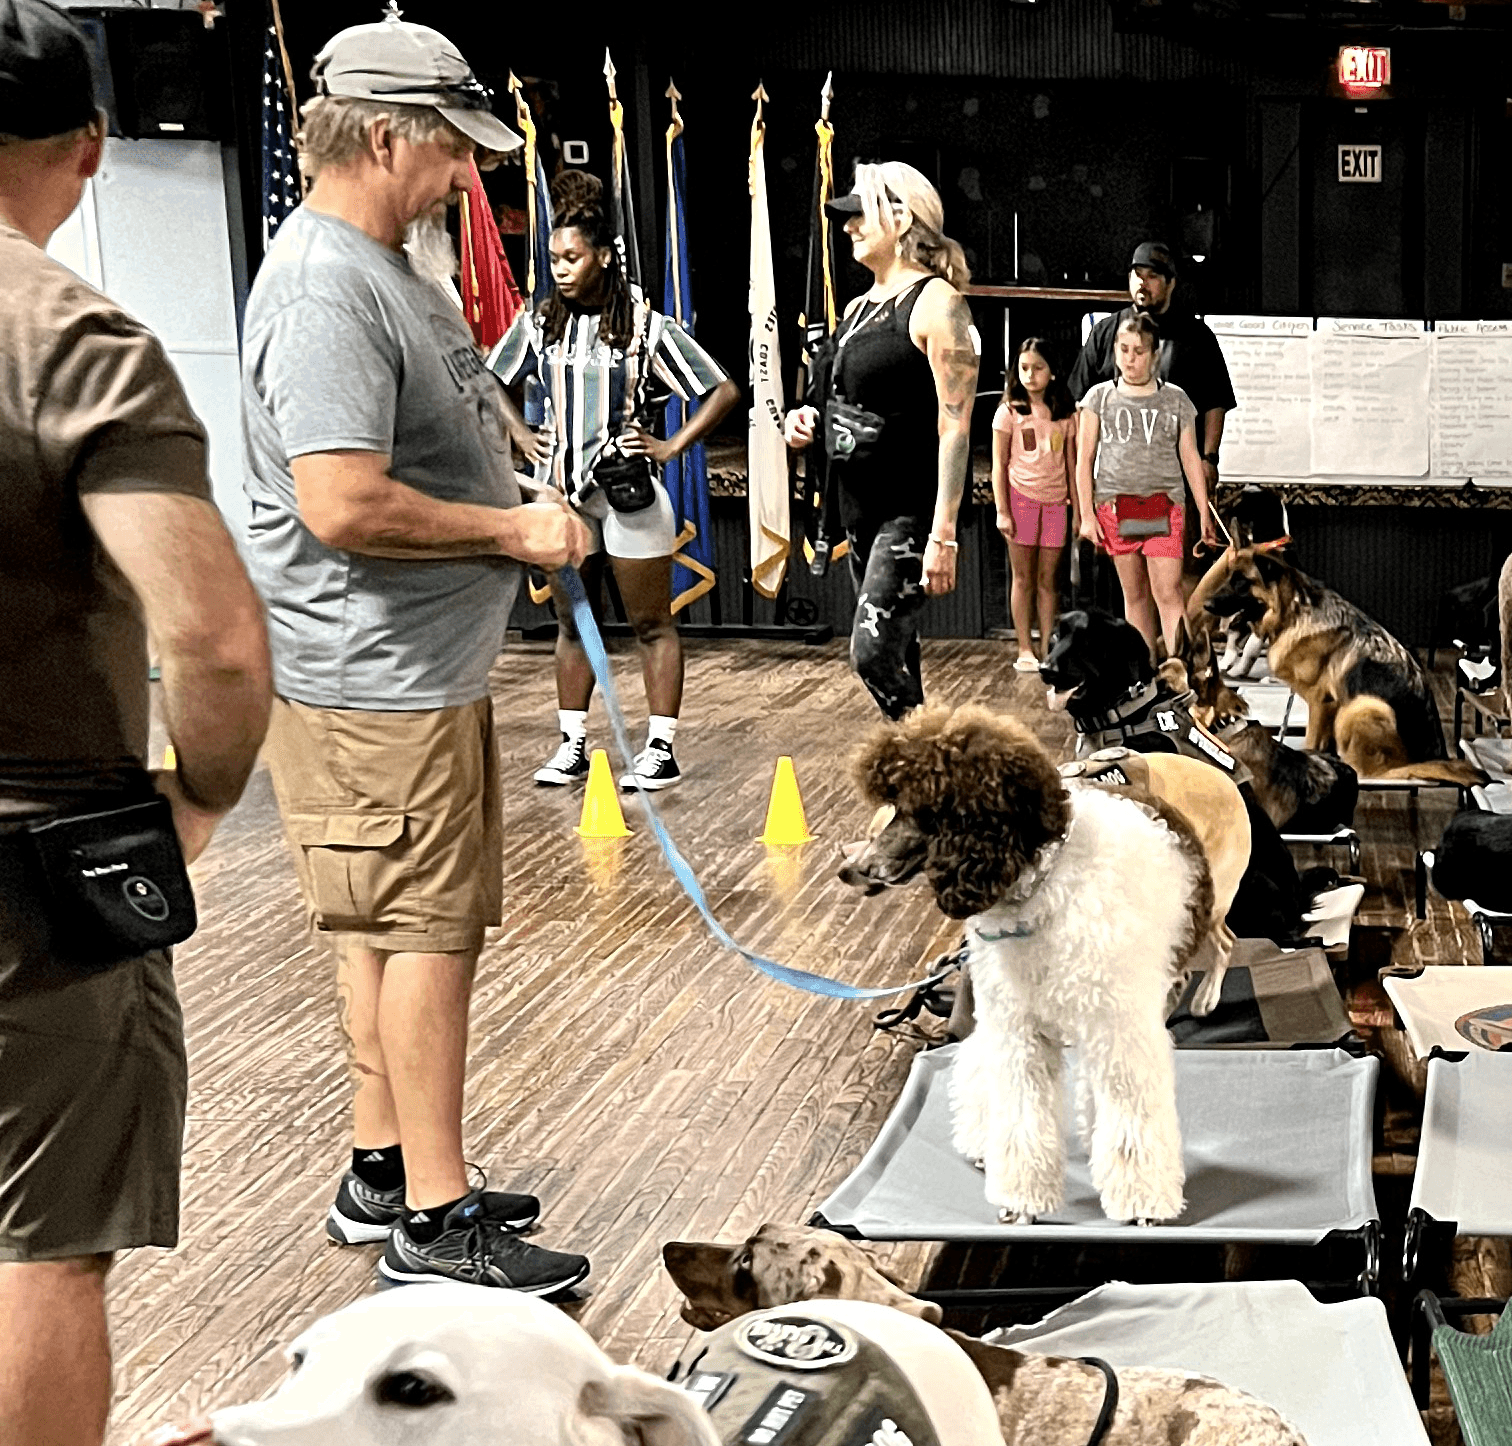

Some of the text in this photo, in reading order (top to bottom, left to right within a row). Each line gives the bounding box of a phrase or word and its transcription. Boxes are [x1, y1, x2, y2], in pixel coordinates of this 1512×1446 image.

[1343, 48, 1387, 81] EXIT
[1341, 149, 1379, 178] EXIT
[1332, 320, 1374, 333] Service
